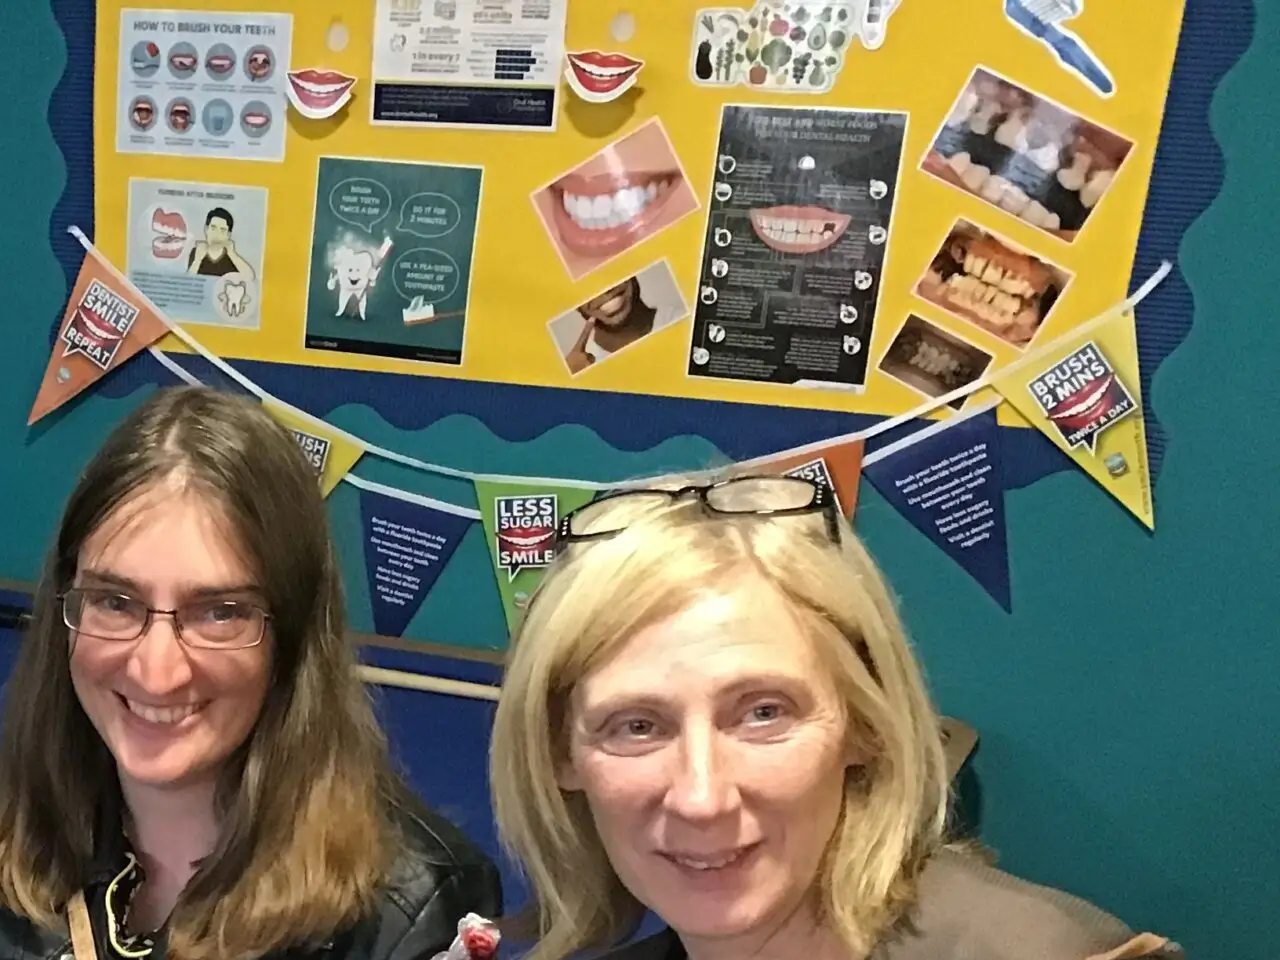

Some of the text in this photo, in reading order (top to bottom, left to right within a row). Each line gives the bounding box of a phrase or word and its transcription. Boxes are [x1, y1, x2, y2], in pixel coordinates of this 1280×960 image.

[133, 20, 276, 36] HOW TO BRUSH YOUR TEETH
[90, 283, 135, 320] DENTIST
[83, 295, 129, 333] SMILE
[66, 327, 111, 363] REPEAT
[1032, 347, 1098, 397] BRUSH
[1042, 360, 1106, 410] 2 MINS
[1068, 399, 1129, 444] TWICE A DAY
[296, 432, 326, 456] USH
[895, 474, 915, 487] Brush
[915, 469, 930, 480] your
[930, 459, 950, 471] teeth
[950, 450, 968, 462] twice
[974, 443, 987, 452] day
[902, 484, 918, 494] with
[949, 452, 987, 472] toothpaste
[908, 496, 921, 505] Use
[960, 471, 974, 482] and
[974, 464, 992, 476] clean
[921, 476, 986, 510] between your teeth
[500, 498, 553, 517] LESS
[960, 492, 973, 502] day
[372, 516, 387, 526] Brush
[388, 522, 400, 530] your
[401, 526, 416, 534] teeth
[416, 530, 432, 539] twice
[436, 536, 447, 544] day
[501, 516, 553, 529] SUGAR
[934, 516, 953, 526] Have
[952, 510, 966, 518] less
[939, 507, 994, 534] foods and drinks
[372, 526, 386, 534] with
[412, 536, 442, 550] toothpaste
[948, 532, 966, 543] Visit
[970, 520, 995, 534] dentist
[960, 532, 990, 548] regularly
[370, 536, 382, 544] Use
[414, 549, 424, 557] and
[424, 552, 440, 561] clean
[377, 546, 429, 566] between your teeth
[500, 549, 553, 564] SMILE
[377, 565, 391, 574] Have
[391, 570, 402, 578] less
[404, 562, 414, 570] day
[376, 573, 420, 590] foods and drinks
[376, 584, 389, 592] Visit
[394, 590, 414, 600] dentist
[381, 594, 406, 606] regularly
